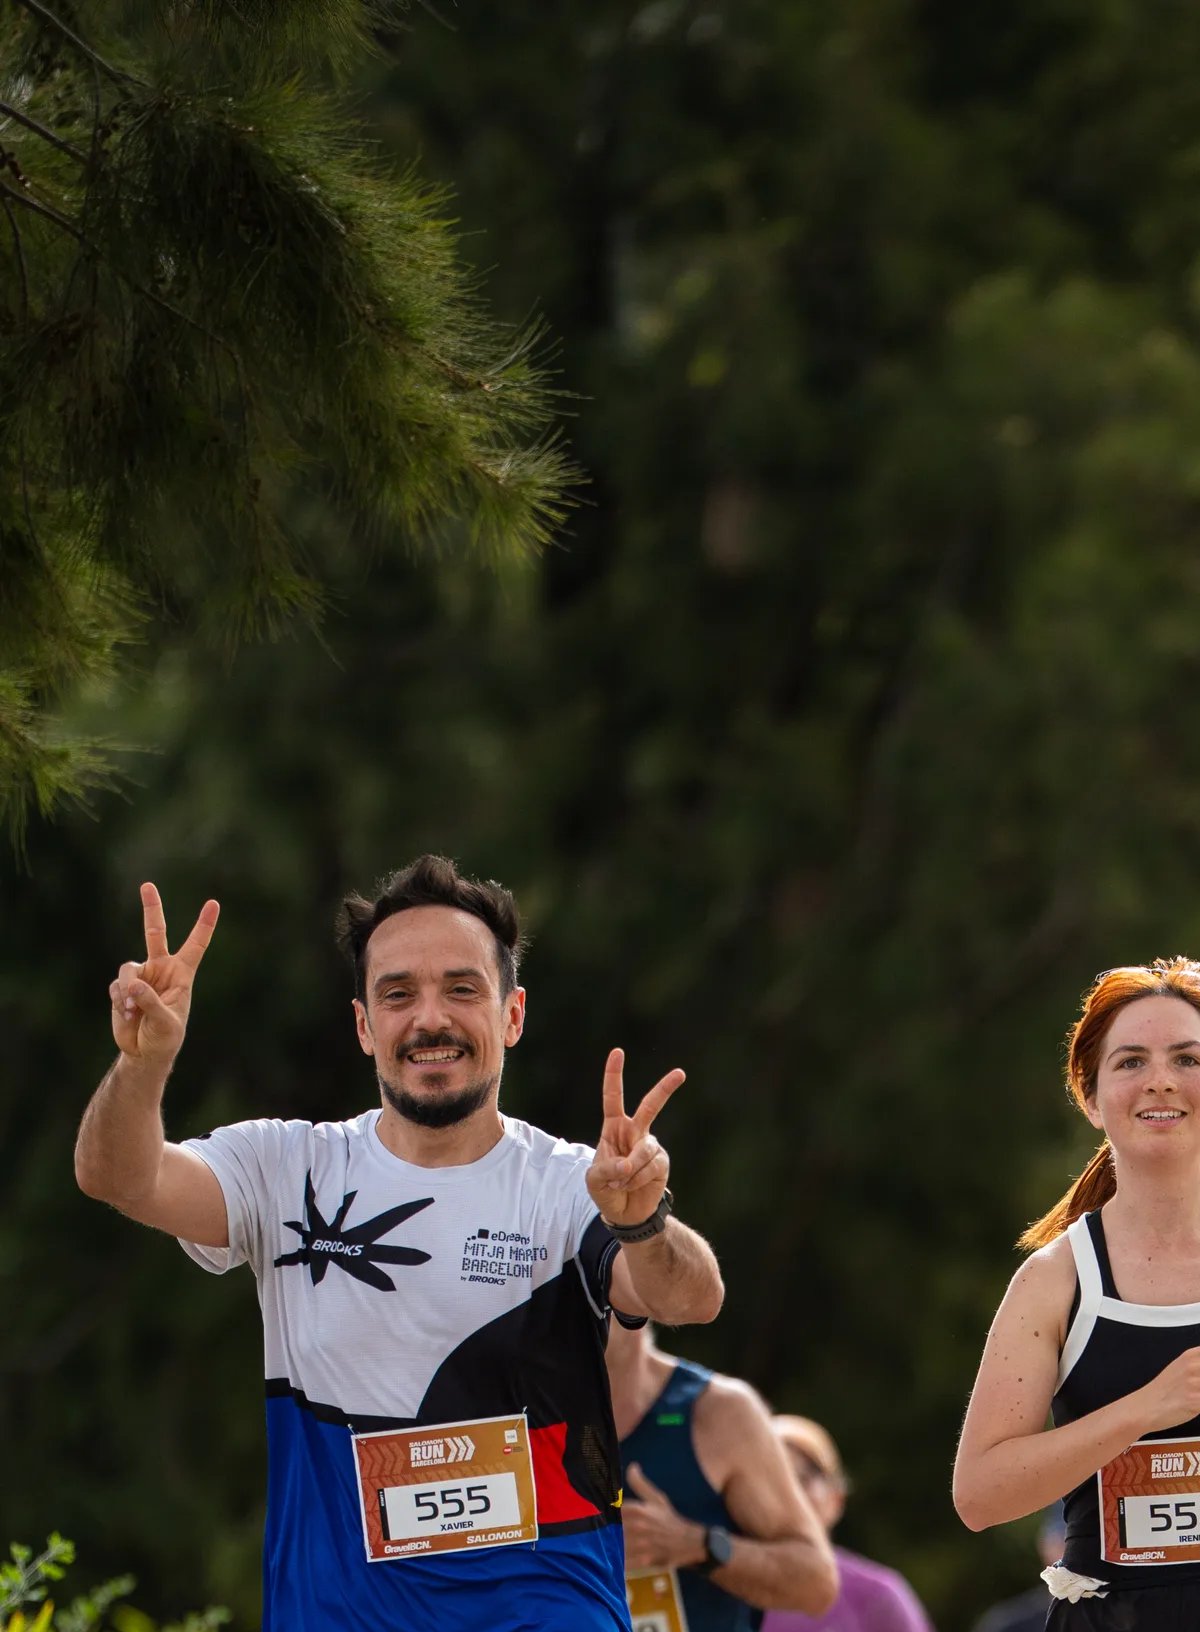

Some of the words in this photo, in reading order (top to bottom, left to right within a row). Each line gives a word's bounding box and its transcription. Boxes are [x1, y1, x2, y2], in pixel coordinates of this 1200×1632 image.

[312, 1239, 365, 1256] BROOKS
[463, 1242, 505, 1260] MITJA
[468, 1274, 507, 1286] BROOKS
[408, 1438, 444, 1448] SALOMON
[410, 1444, 445, 1462] RUN
[411, 1457, 447, 1468] BARCELONA
[1150, 1458, 1185, 1473] RUN
[1151, 1470, 1185, 1479] BARCELONA
[414, 1485, 491, 1522] 555
[440, 1520, 474, 1532] XAVIER
[466, 1529, 523, 1545] SALOMON
